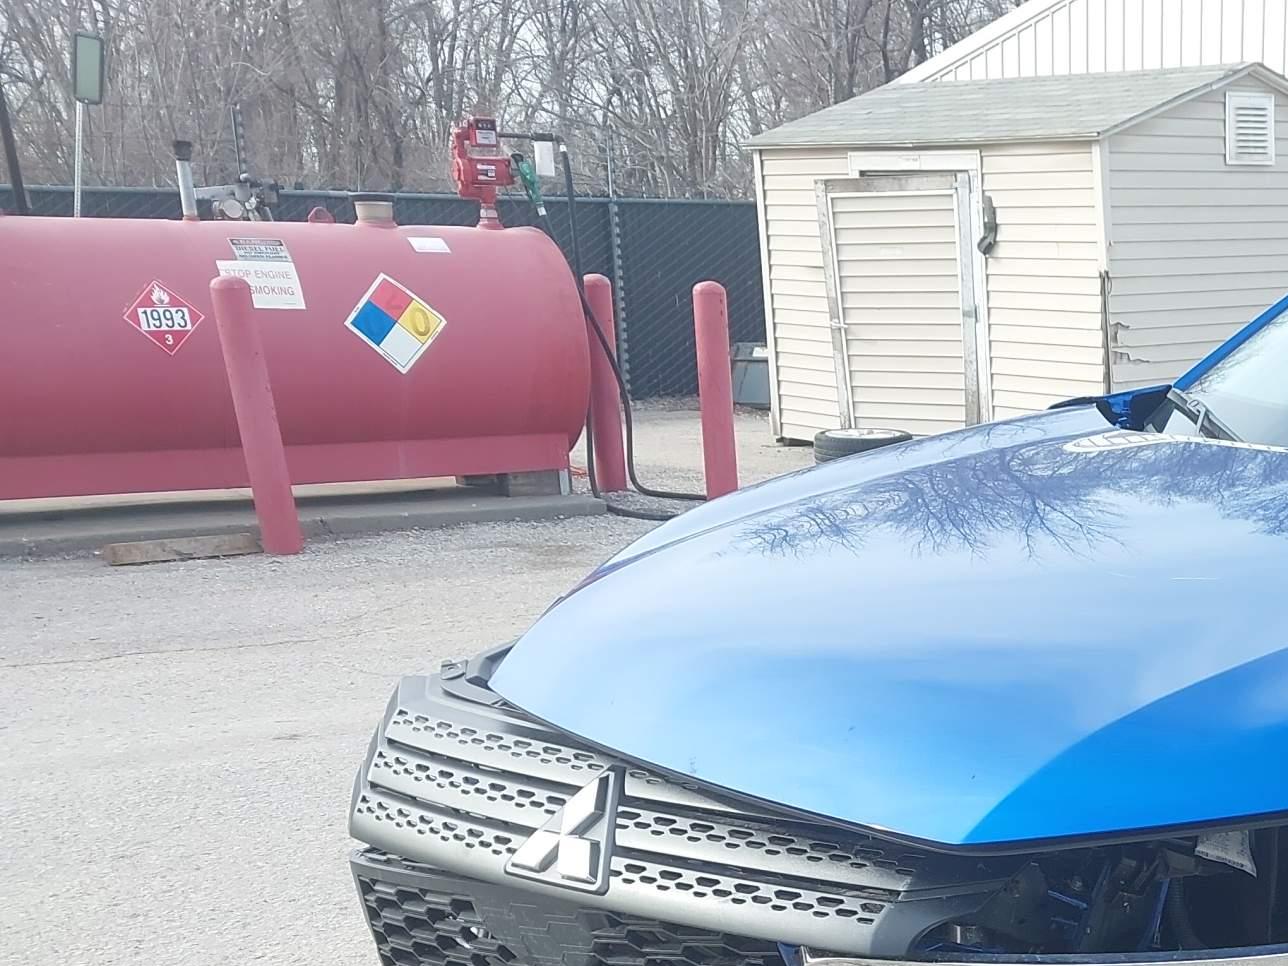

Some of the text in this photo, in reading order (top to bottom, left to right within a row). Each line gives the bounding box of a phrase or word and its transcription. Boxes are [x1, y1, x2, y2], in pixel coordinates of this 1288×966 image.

[254, 270, 292, 280] ENGINE
[250, 285, 295, 296] SMOKING
[141, 308, 188, 329] 1993
[164, 333, 174, 345] 3
